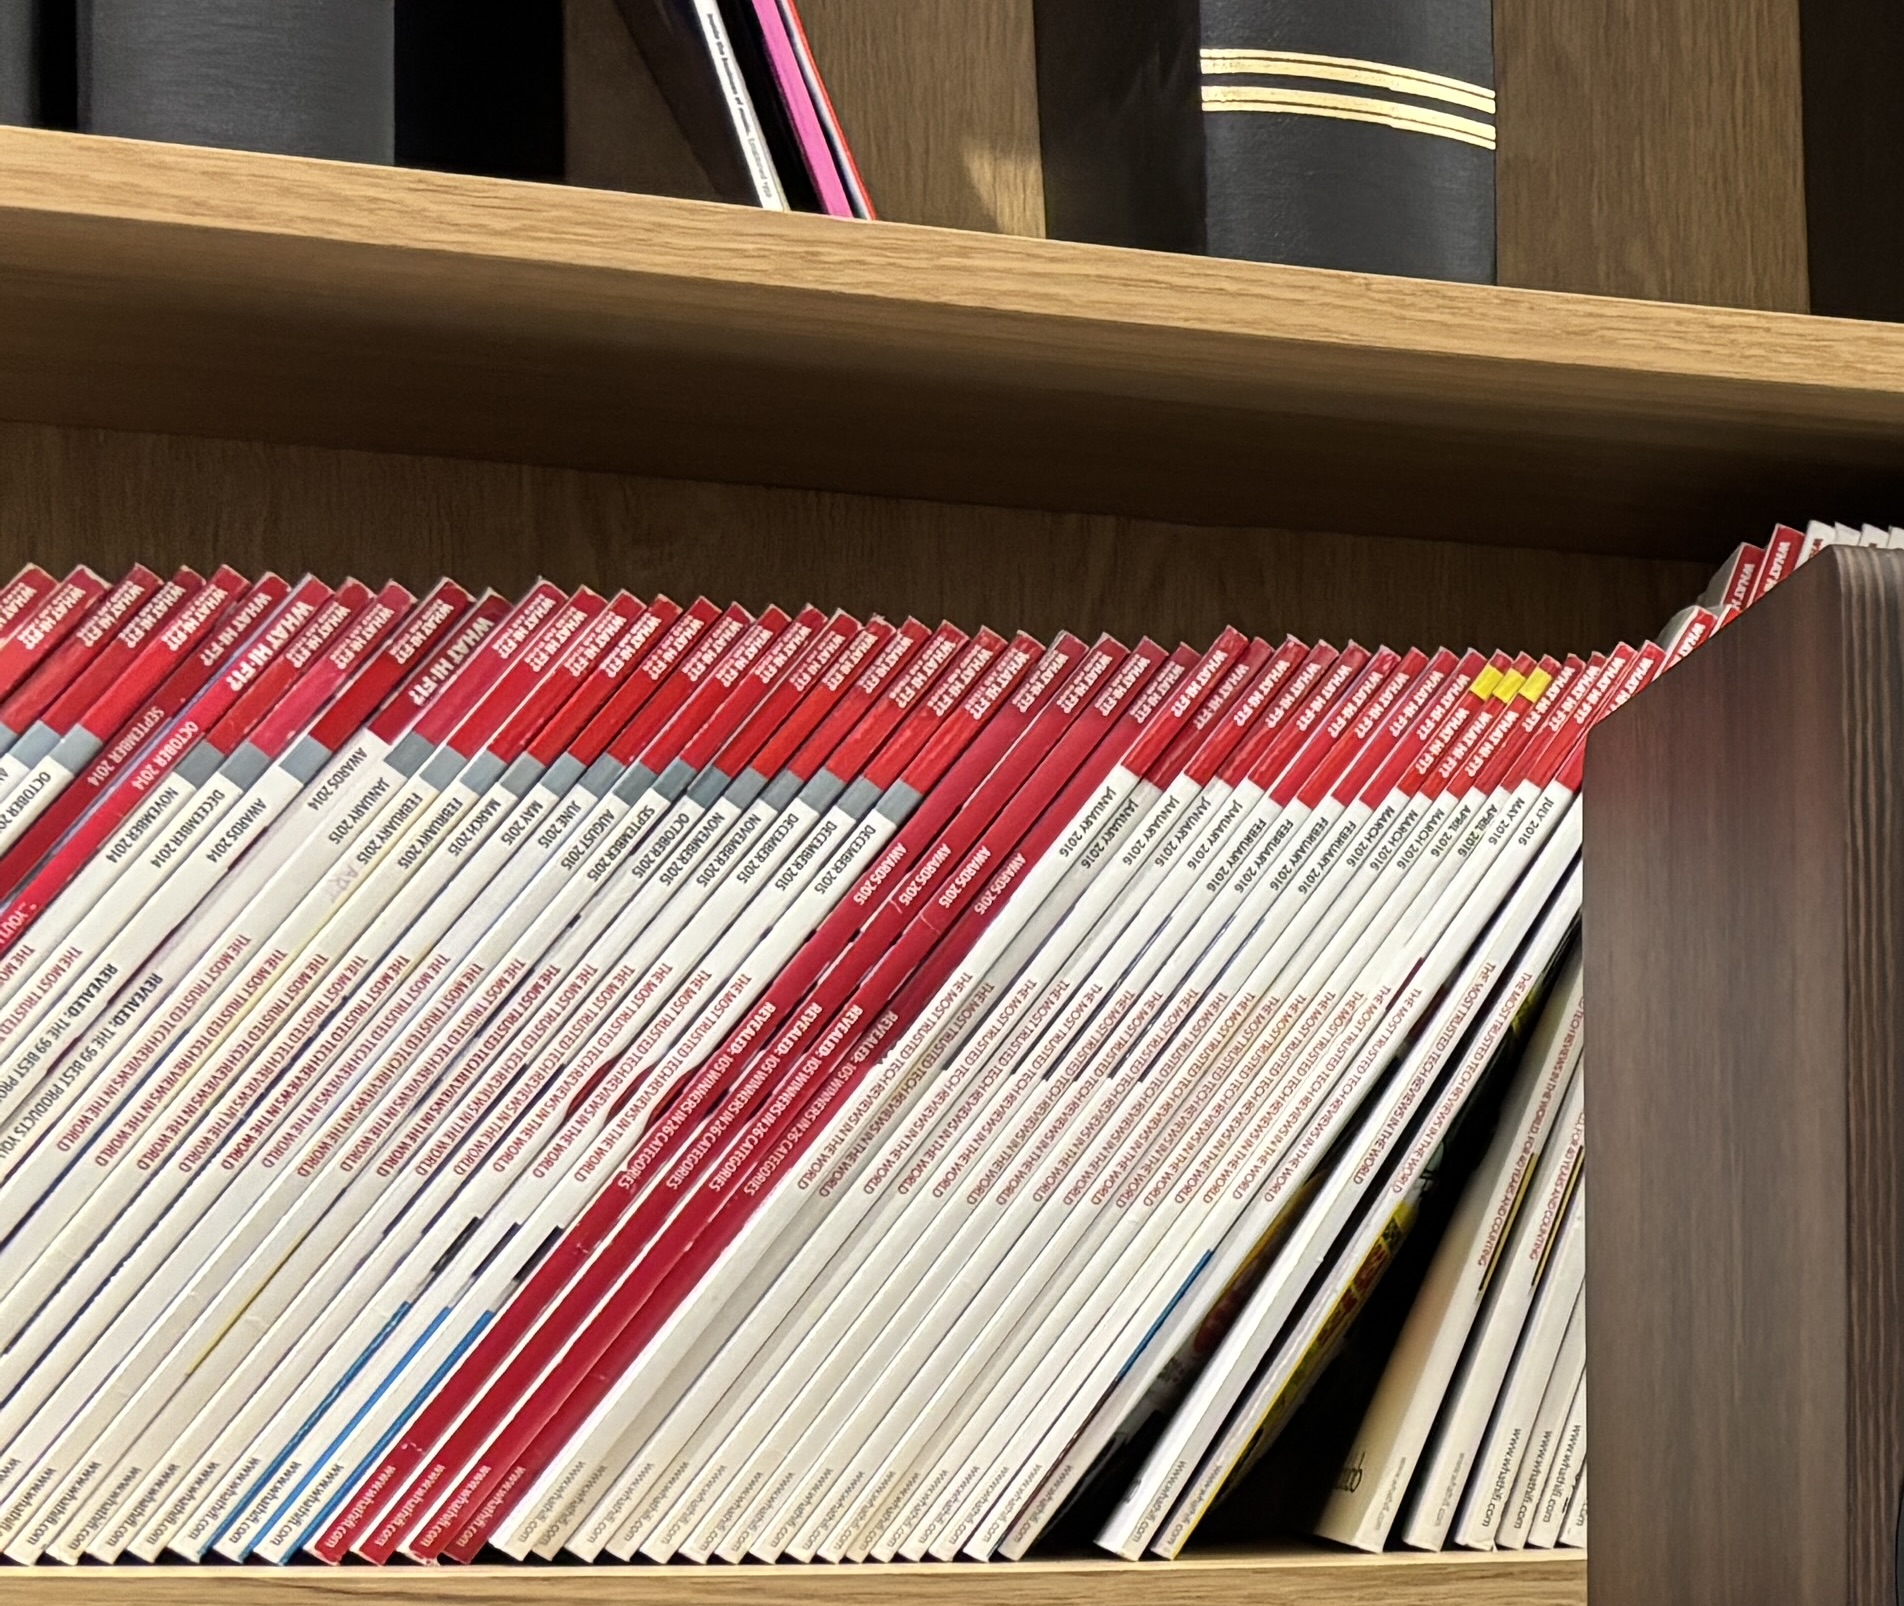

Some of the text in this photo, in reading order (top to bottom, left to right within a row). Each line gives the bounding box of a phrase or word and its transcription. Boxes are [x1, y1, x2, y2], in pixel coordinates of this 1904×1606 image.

[262, 602, 314, 644] WHAT
[447, 616, 494, 663] WHAT
[87, 705, 165, 786] SEPTEMBER 2014
[1443, 707, 1469, 742] WHAT
[132, 721, 199, 791] OCTOBER 2014
[105, 786, 179, 863] NOVEMBER 2014
[151, 789, 225, 868] DECEMBER 2014
[206, 798, 267, 862] AWARDS 2014
[328, 777, 390, 845] JANUARY 2015
[448, 798, 502, 857] MARCH 2015
[501, 800, 543, 846] MAY 2015
[560, 809, 614, 871] AUGUST 2015
[1059, 786, 1117, 858] JANUARY 2016
[1518, 797, 1554, 846] JULY 2016
[631, 813, 689, 879] OCTOBER 2015
[659, 812, 725, 886] NOVEMBER 2015
[736, 813, 799, 885] DECEMBER 2015
[853, 843, 907, 906] AWARDS 2015
[1270, 816, 1329, 891] FEBRUARY 2016
[1463, 982, 1485, 1010] MOST
[1479, 962, 1496, 985] THE
[15, 973, 163, 1142] REVEALED: THE 99 BEST PRODUCTS
[1436, 1008, 1466, 1050] TRUSTED
[1422, 1047, 1442, 1076] TECH
[618, 1002, 776, 1189] REVEALED: 105 WINNERS IN 26 CATEGORIES
[1397, 1072, 1425, 1118] REVIEWS
[1353, 1147, 1381, 1185] WORLD
[1376, 1127, 1393, 1152] THE
